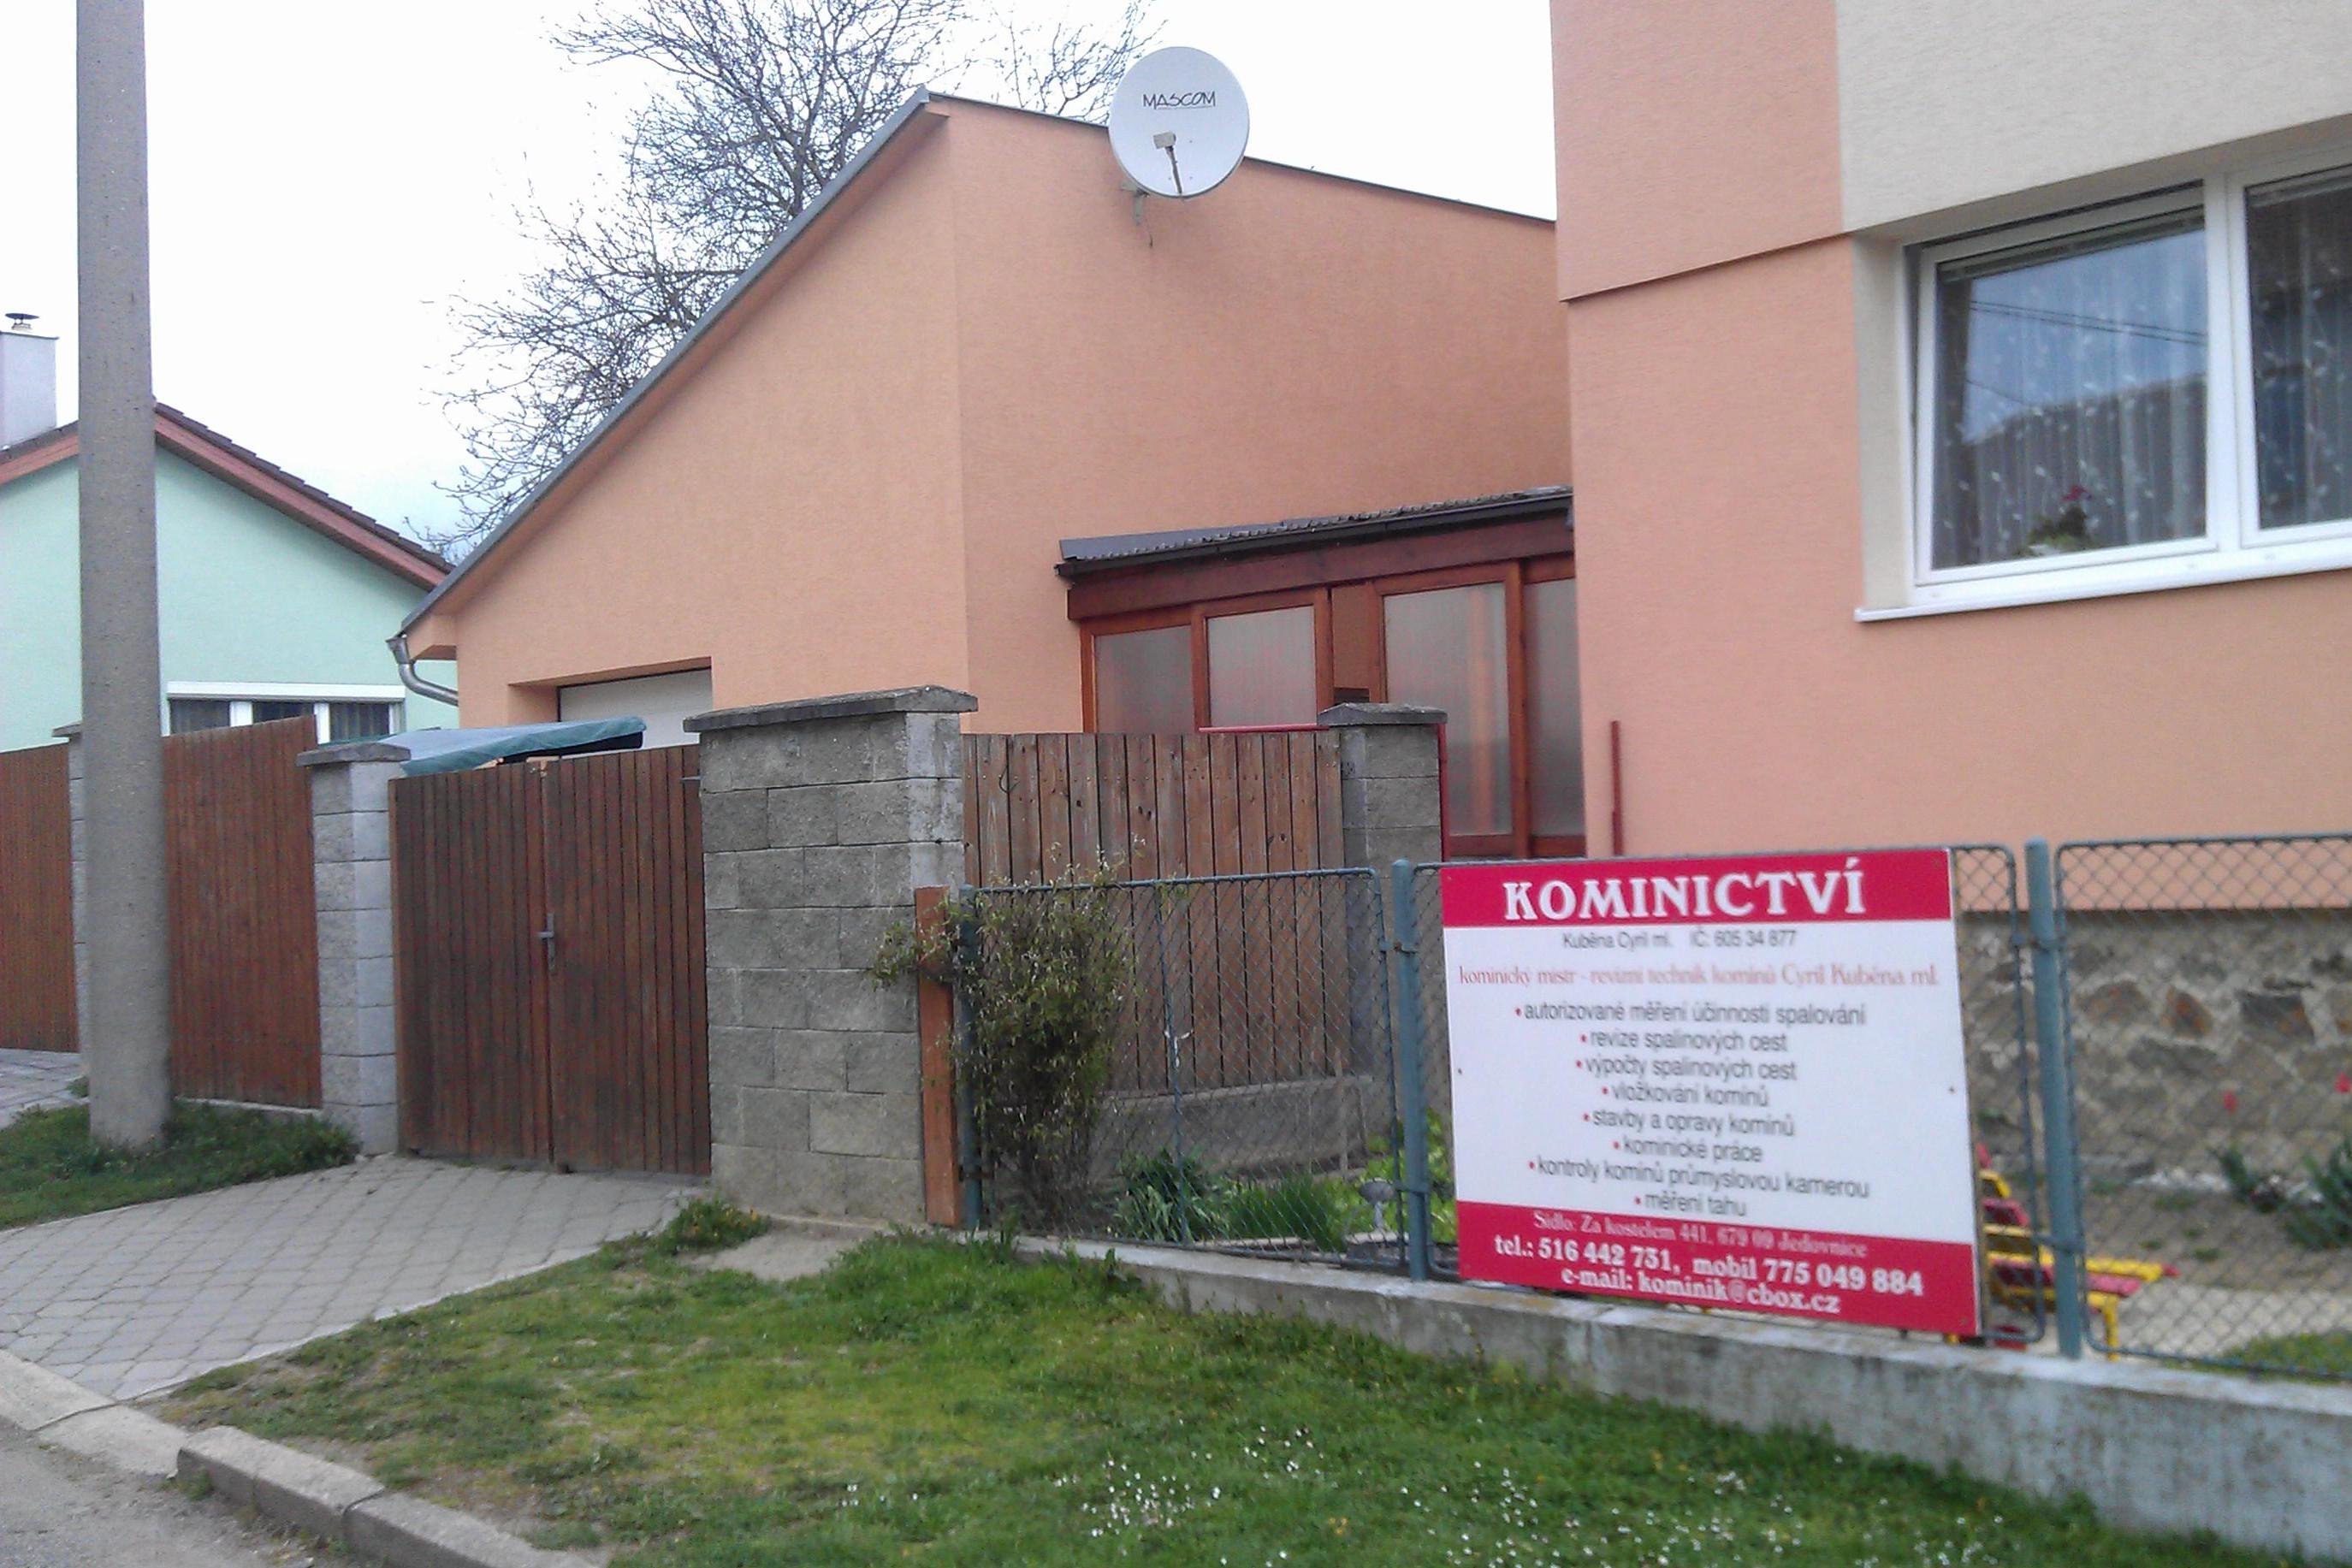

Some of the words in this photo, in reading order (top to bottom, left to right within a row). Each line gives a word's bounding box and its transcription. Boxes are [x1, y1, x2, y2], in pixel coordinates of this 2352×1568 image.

[1143, 91, 1216, 109] MASCOM
[1504, 856, 1865, 921] KOMINICTVÍ
[1563, 932, 1614, 950] Kuběna
[1746, 929, 1764, 947] 34
[1768, 929, 1796, 947] 877
[1538, 967, 1577, 984] mistr
[1781, 962, 1826, 988] Cyril
[1525, 1000, 1625, 1021] autorizované
[1775, 1003, 1866, 1028] spalování
[1590, 1029, 1638, 1048] revize
[1645, 1029, 1745, 1054] spalinových
[1750, 1033, 1788, 1051] cest
[1652, 1056, 1754, 1081] spalinových
[1758, 1060, 1798, 1080] cest
[1611, 1081, 1700, 1102] vložkování
[1592, 1109, 1645, 1133] stavby
[1651, 1114, 1662, 1128] a
[1666, 1114, 1724, 1137] opravy
[1713, 1139, 1763, 1165] práce
[1537, 1154, 1600, 1183] kontroly
[1669, 1162, 1780, 1192] průmyslovou
[1785, 1171, 1870, 1198] kamerou
[1708, 1196, 1747, 1216] tahu
[1581, 1213, 1602, 1234] Za
[1495, 1234, 1534, 1258] tel.:
[1538, 1236, 1579, 1262] 516
[1584, 1241, 1625, 1267] 442
[1630, 1246, 1681, 1275] 751,
[1692, 1254, 1757, 1281] mobil
[1763, 1257, 1810, 1285] 775
[1816, 1263, 1866, 1291] 049
[1872, 1268, 1924, 1297] 884
[1561, 1267, 1633, 1291] e-mail:
[1638, 1269, 1841, 1314] kominik@cbox.cz
